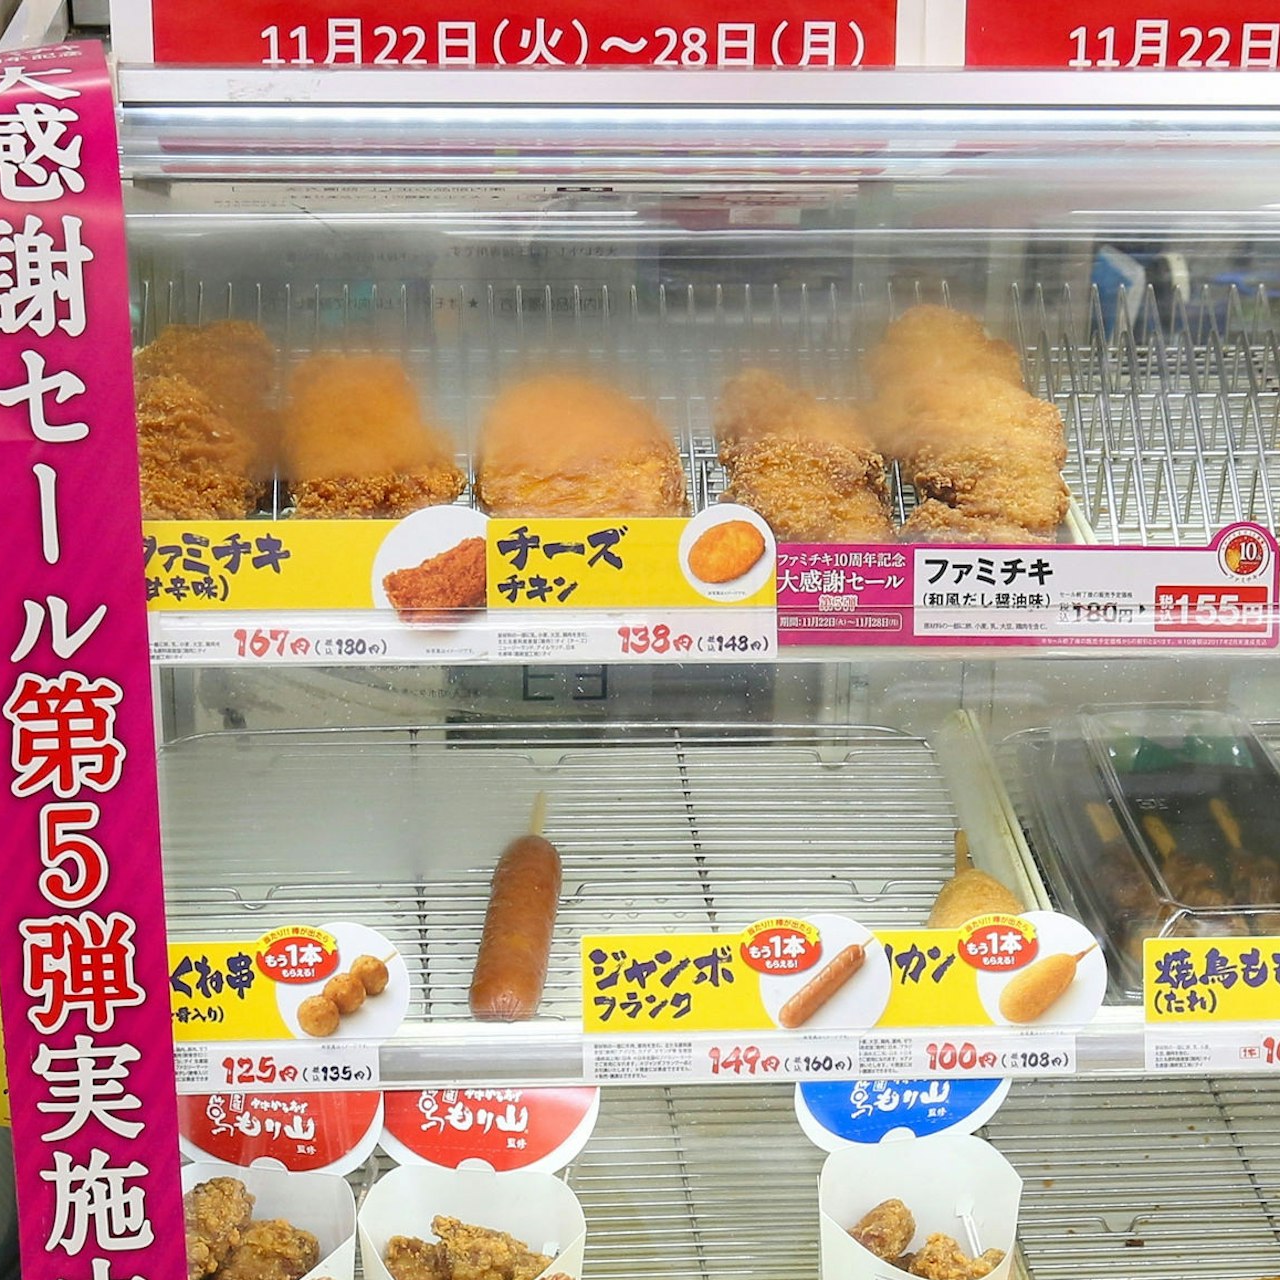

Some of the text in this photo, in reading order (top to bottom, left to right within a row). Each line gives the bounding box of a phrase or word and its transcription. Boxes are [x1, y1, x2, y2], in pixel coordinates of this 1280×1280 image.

[500, 528, 627, 572] チーズ
[777, 551, 906, 568] ファミチキ10周年記念
[777, 572, 904, 593] 大感謝セール
[924, 558, 1054, 586] ファミチキ
[498, 578, 579, 603] チキン
[233, 628, 312, 658] 167円
[588, 943, 735, 991] ジャンボ
[593, 991, 693, 1021] フランク
[1153, 989, 1217, 1015] (たれ)
[927, 1042, 997, 1071] 100円
[222, 1057, 299, 1085] 125円
